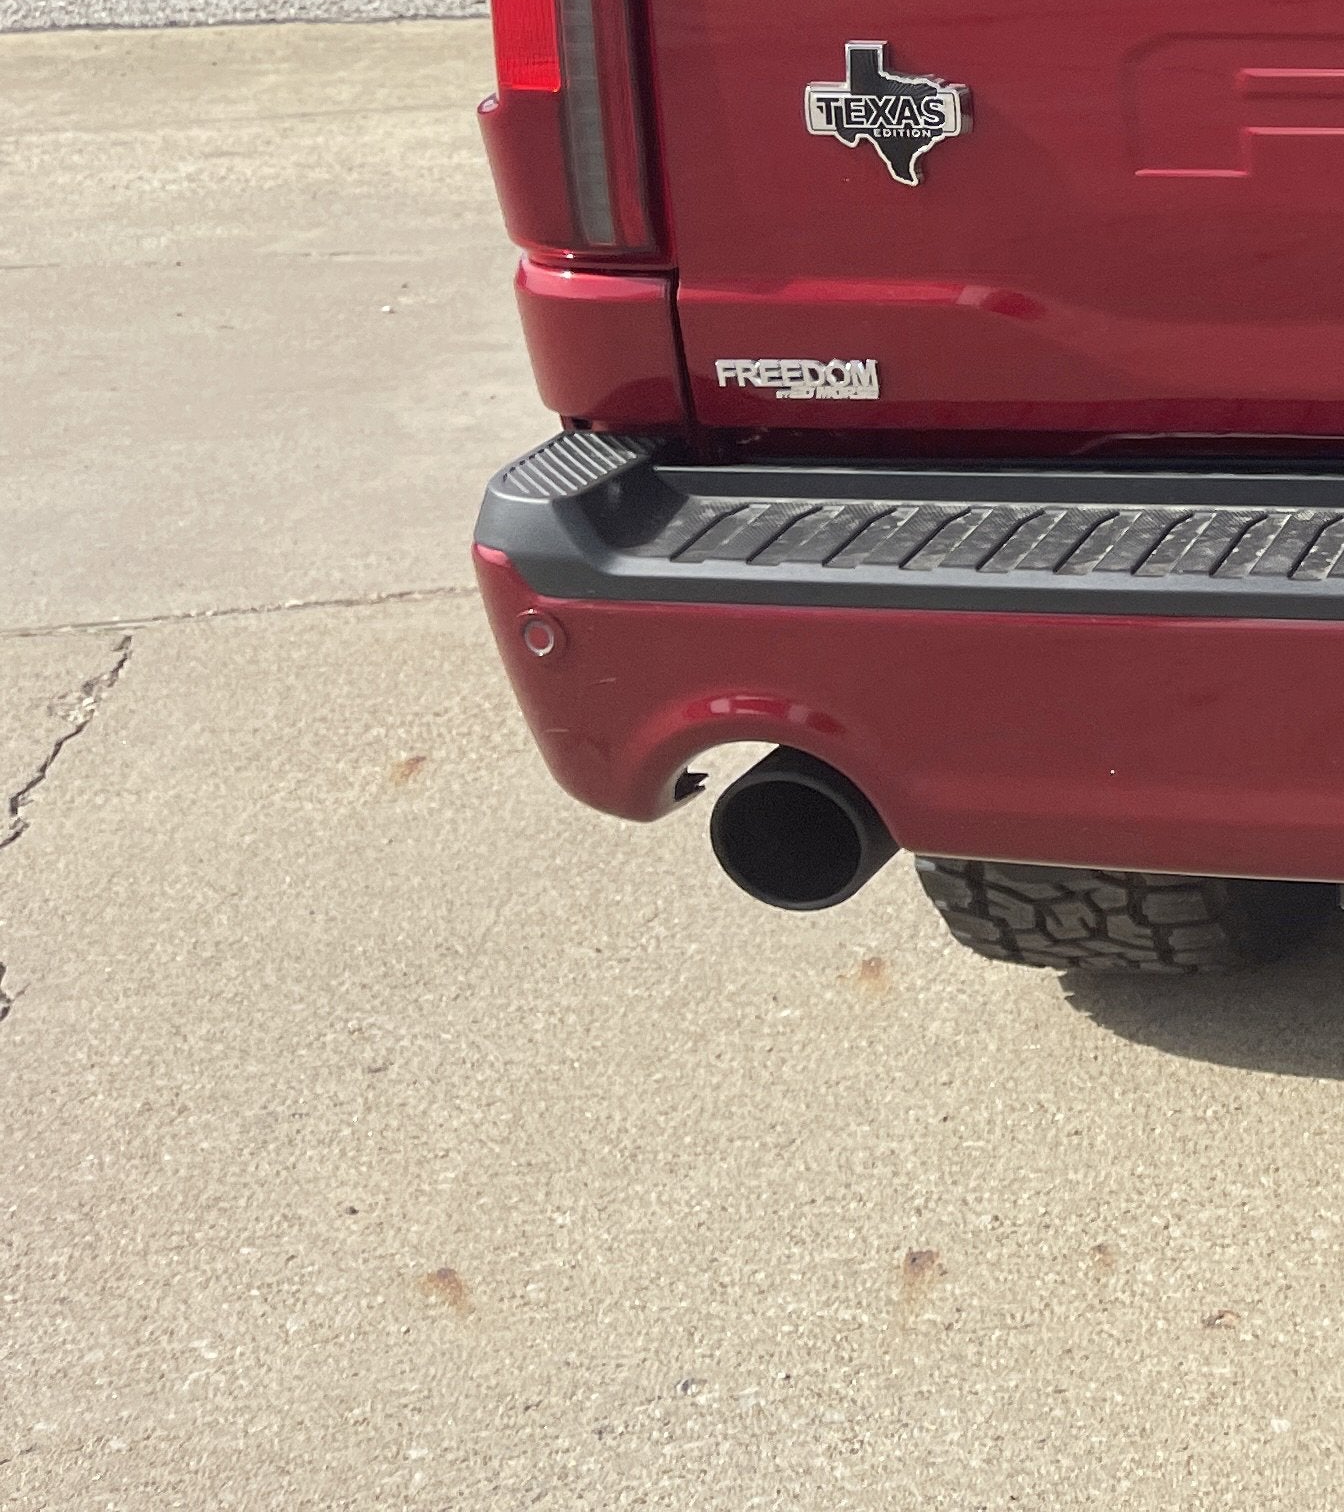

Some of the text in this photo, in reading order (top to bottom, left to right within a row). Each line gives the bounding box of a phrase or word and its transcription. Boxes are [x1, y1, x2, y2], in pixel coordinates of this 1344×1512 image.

[816, 95, 946, 129] TEXAS
[873, 128, 931, 138] EDITION
[715, 359, 878, 387] FREEDOM
